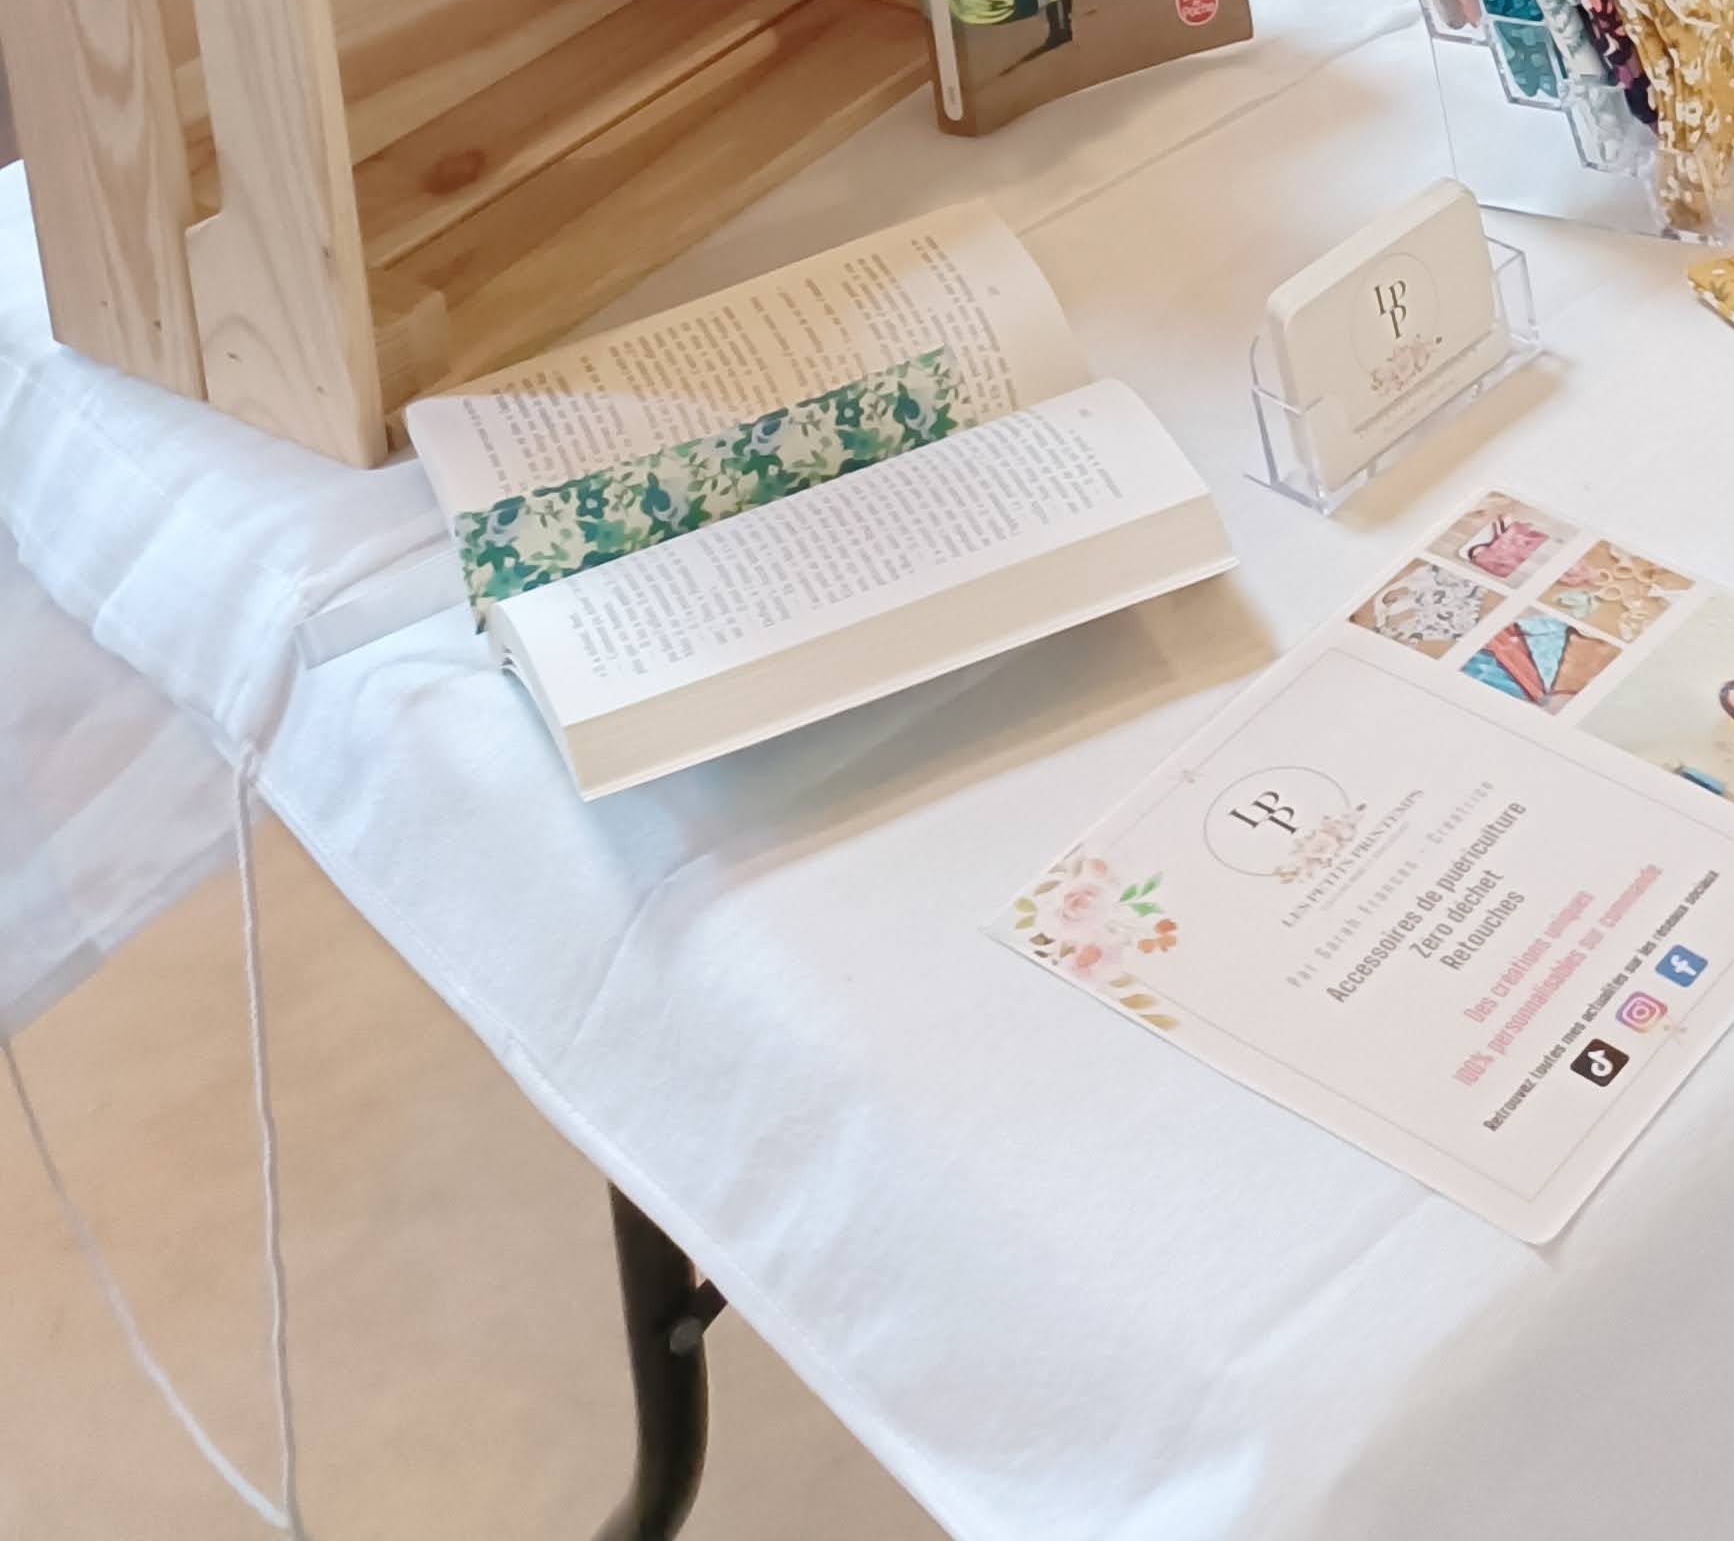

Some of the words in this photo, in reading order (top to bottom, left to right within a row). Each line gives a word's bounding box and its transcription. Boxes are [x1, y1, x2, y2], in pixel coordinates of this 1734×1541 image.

[1326, 910, 1424, 1004] Accessoires
[1416, 889, 1443, 913] de
[1435, 802, 1527, 894] puériculture
[1440, 889, 1525, 971] Retouches
[1453, 1049, 1495, 1088] 100%
[1487, 948, 1588, 1057] personnalisables
[1578, 927, 1606, 951] sur
[1463, 996, 1499, 1023] Des
[1483, 1071, 1537, 1133] Retrouvez
[1532, 1043, 1568, 1081] toutes
[1561, 1021, 1587, 1047] mes
[1623, 954, 1643, 974] sur
[1636, 940, 1658, 957] les
[1684, 869, 1720, 905] sociaux
